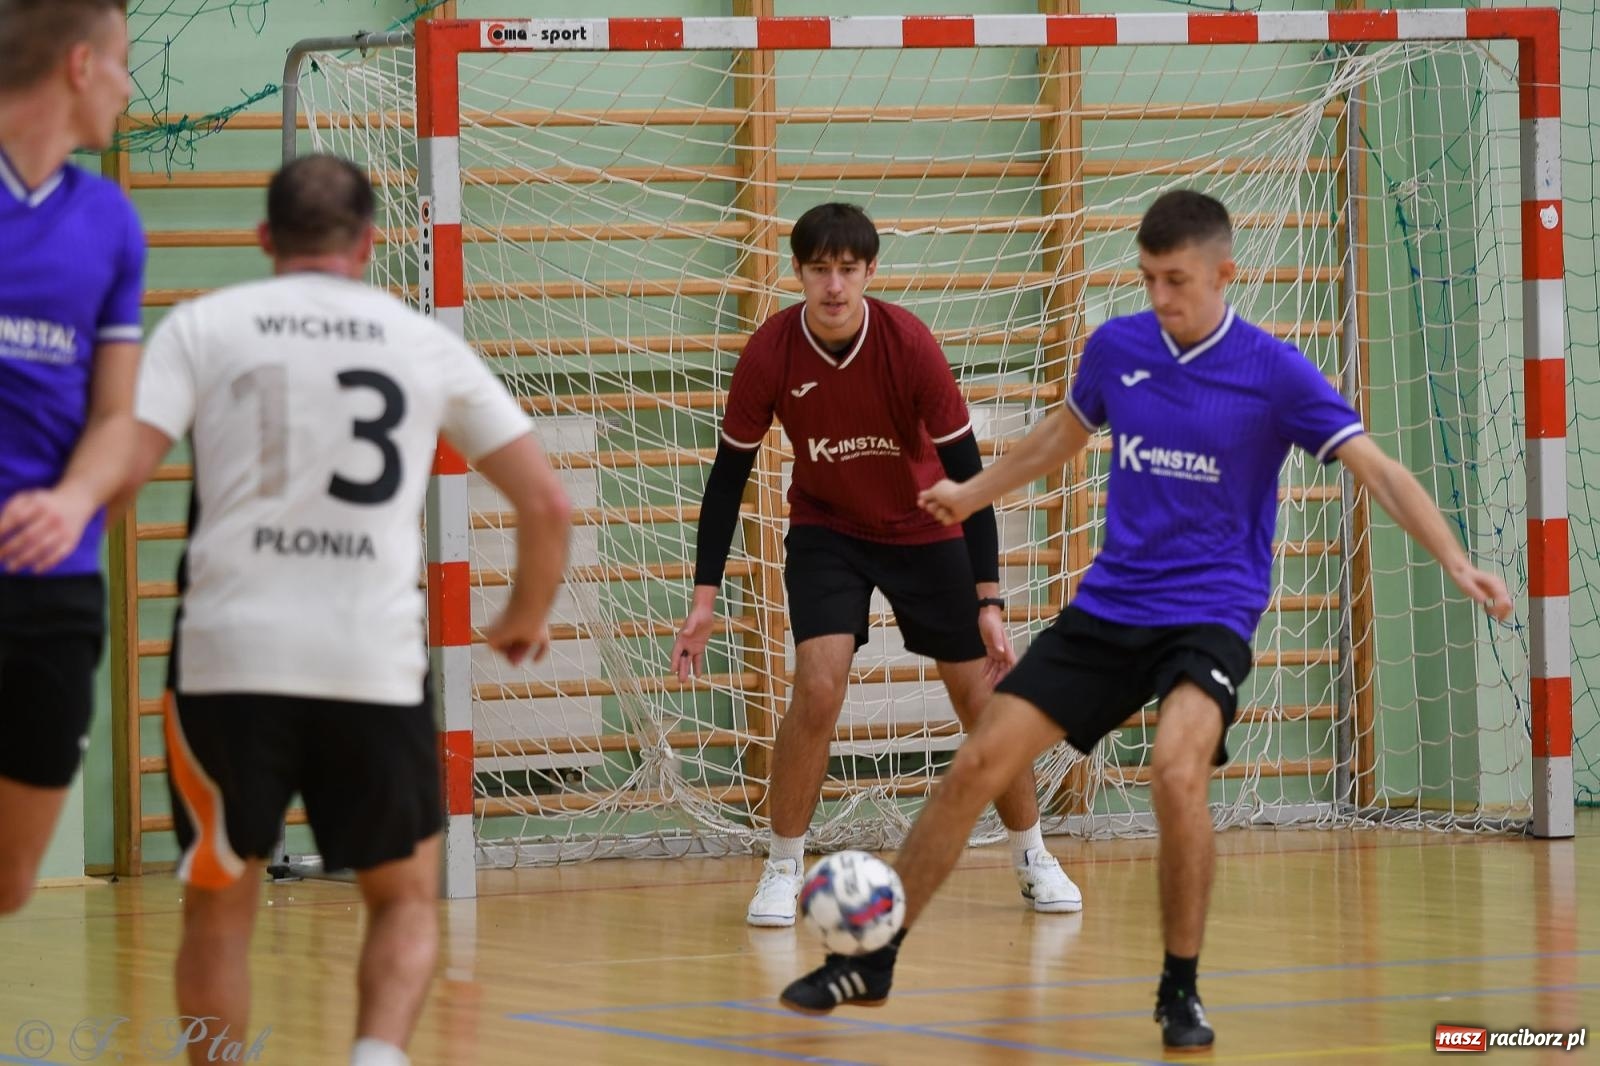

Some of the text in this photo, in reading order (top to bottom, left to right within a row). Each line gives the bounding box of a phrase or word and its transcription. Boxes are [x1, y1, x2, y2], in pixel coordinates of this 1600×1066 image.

[541, 26, 587, 44] sport
[254, 315, 387, 342] WICHER
[231, 361, 406, 506] 13
[253, 527, 376, 560] PŁONIA
